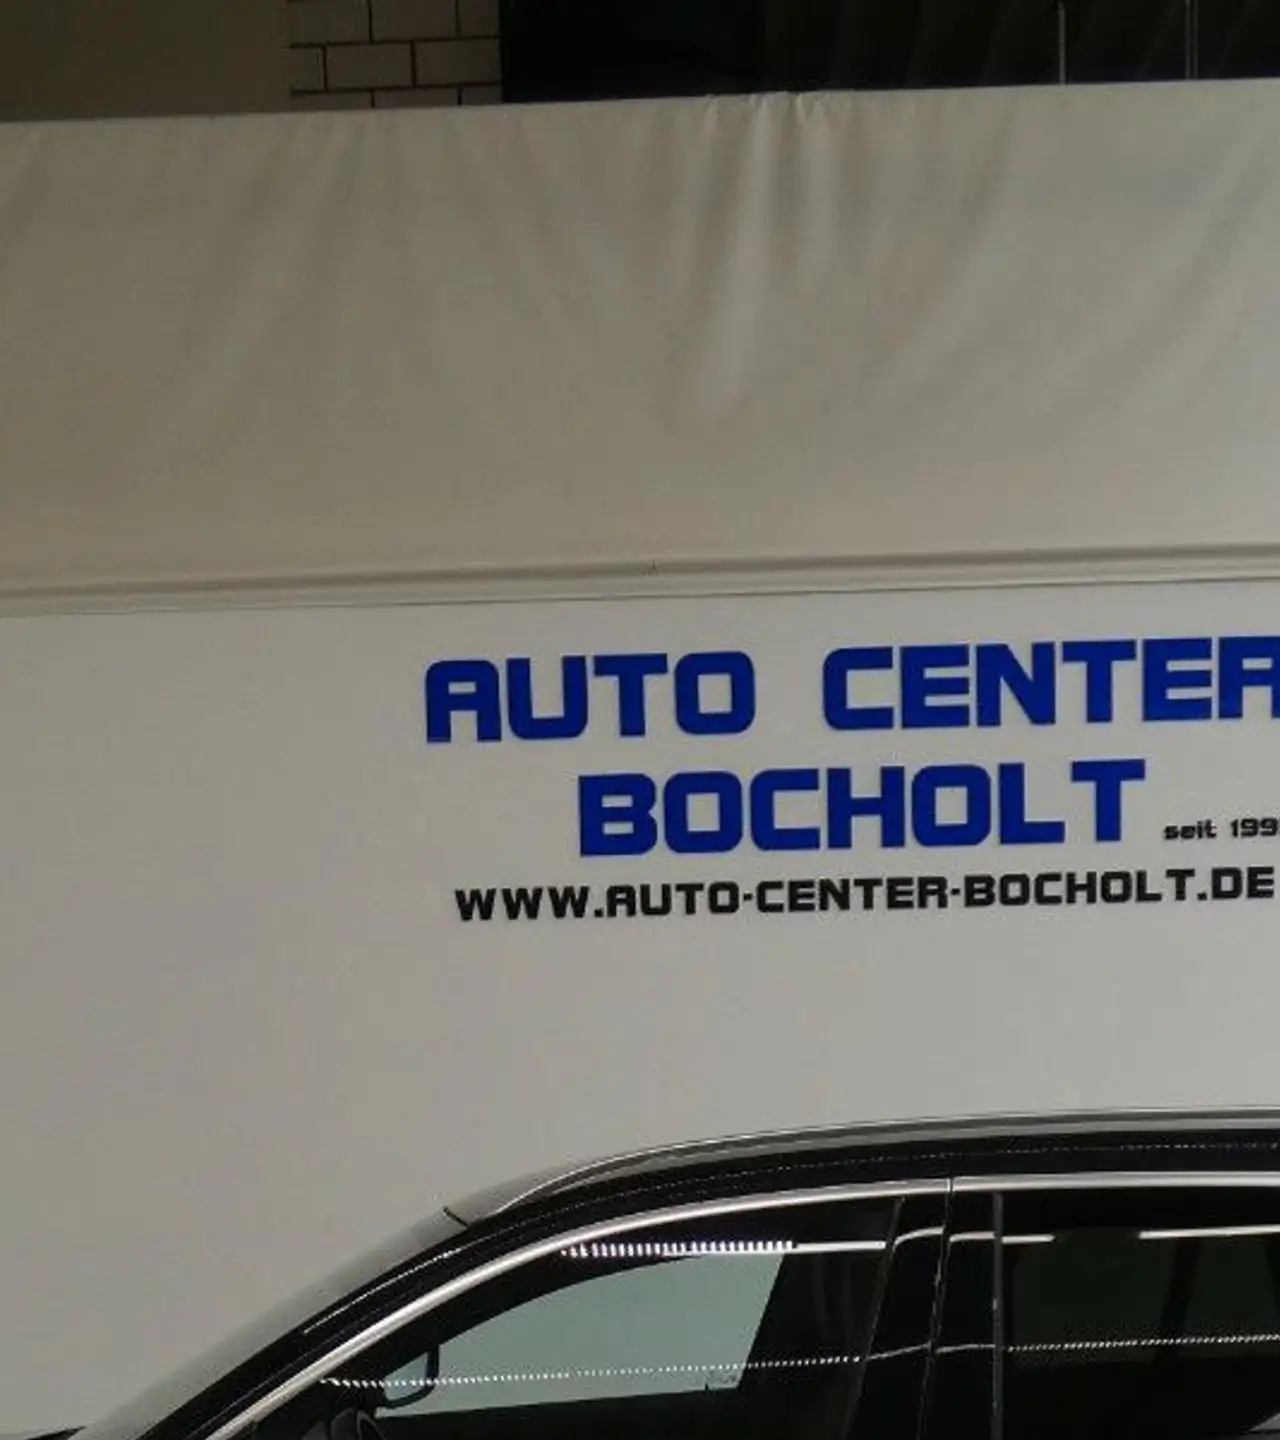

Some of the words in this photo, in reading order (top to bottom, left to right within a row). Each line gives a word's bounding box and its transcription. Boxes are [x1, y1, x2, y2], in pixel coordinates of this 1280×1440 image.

[425, 651, 757, 743] AUTO
[578, 758, 1146, 857] BOCHOLT
[1163, 818, 1218, 840] seit
[454, 866, 1275, 922] WWW.AUTO-CENTER-BOCHOLT.DE
